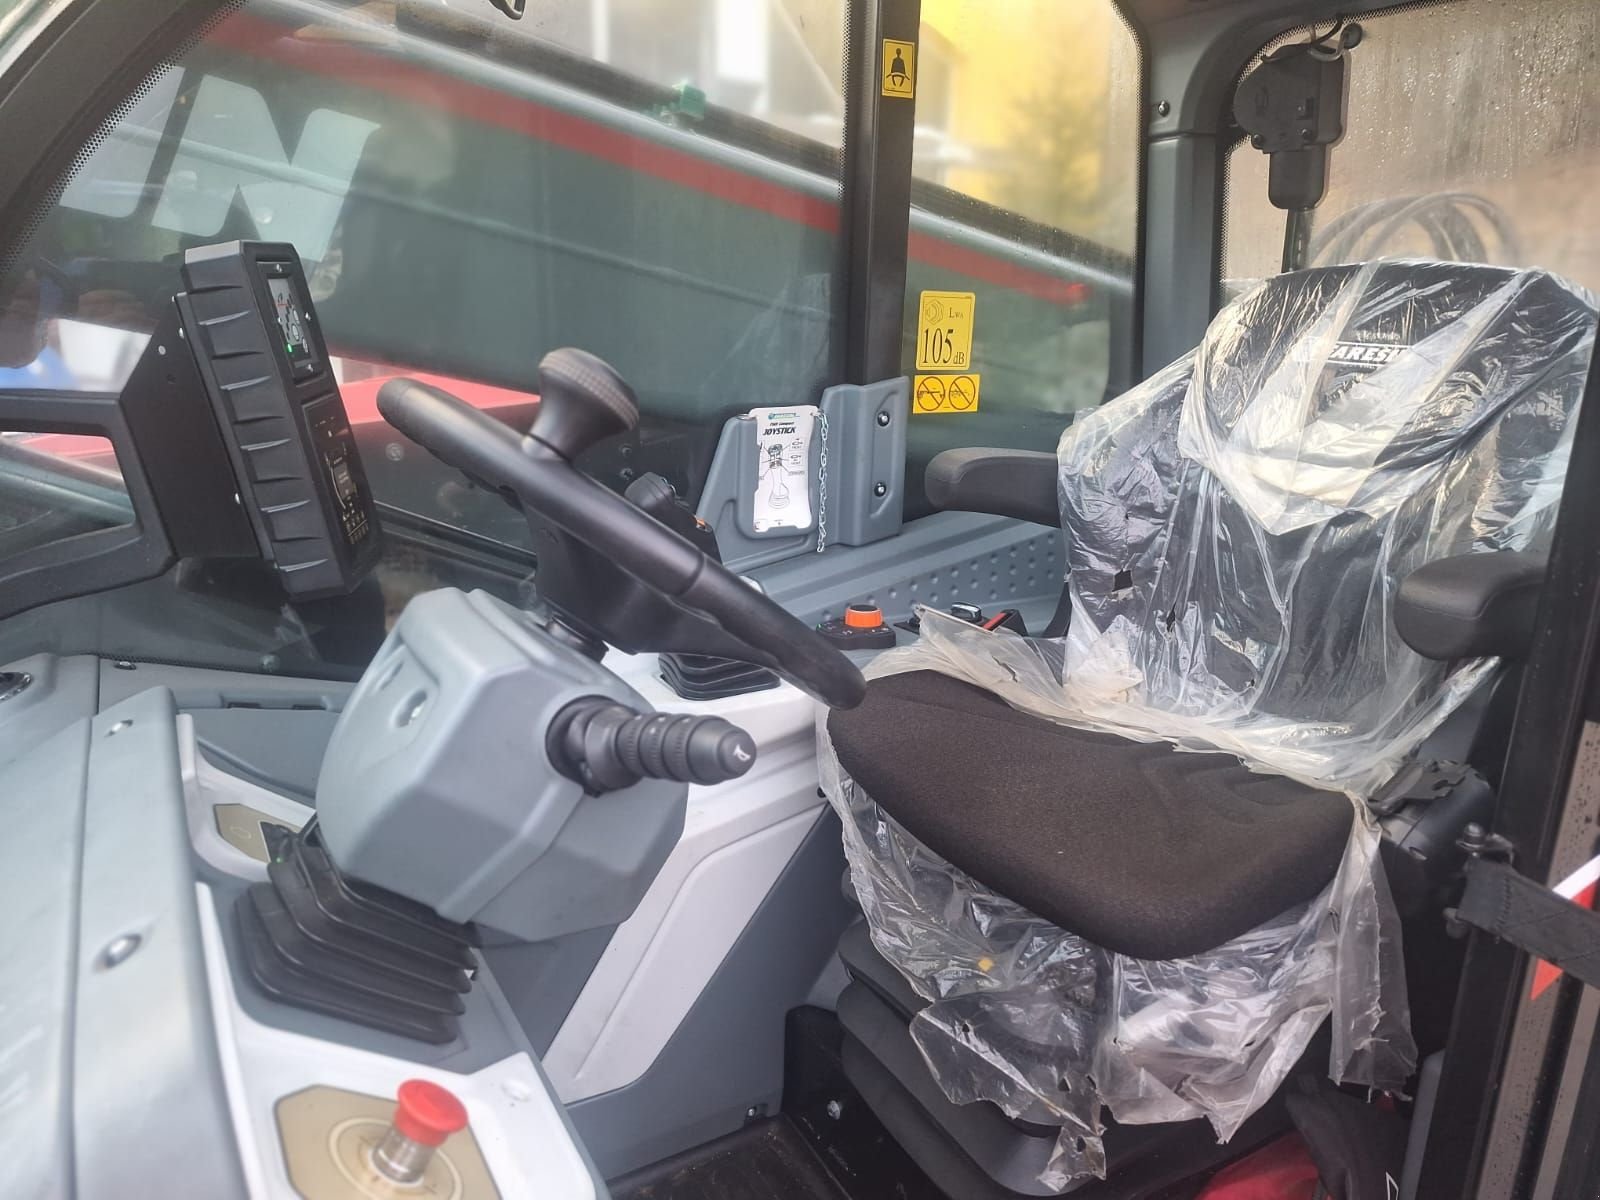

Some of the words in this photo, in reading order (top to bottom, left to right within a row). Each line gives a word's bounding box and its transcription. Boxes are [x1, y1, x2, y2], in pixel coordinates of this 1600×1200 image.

[922, 328, 954, 364] 105
[953, 352, 965, 364] dB
[763, 427, 796, 436] JOYSTICK
